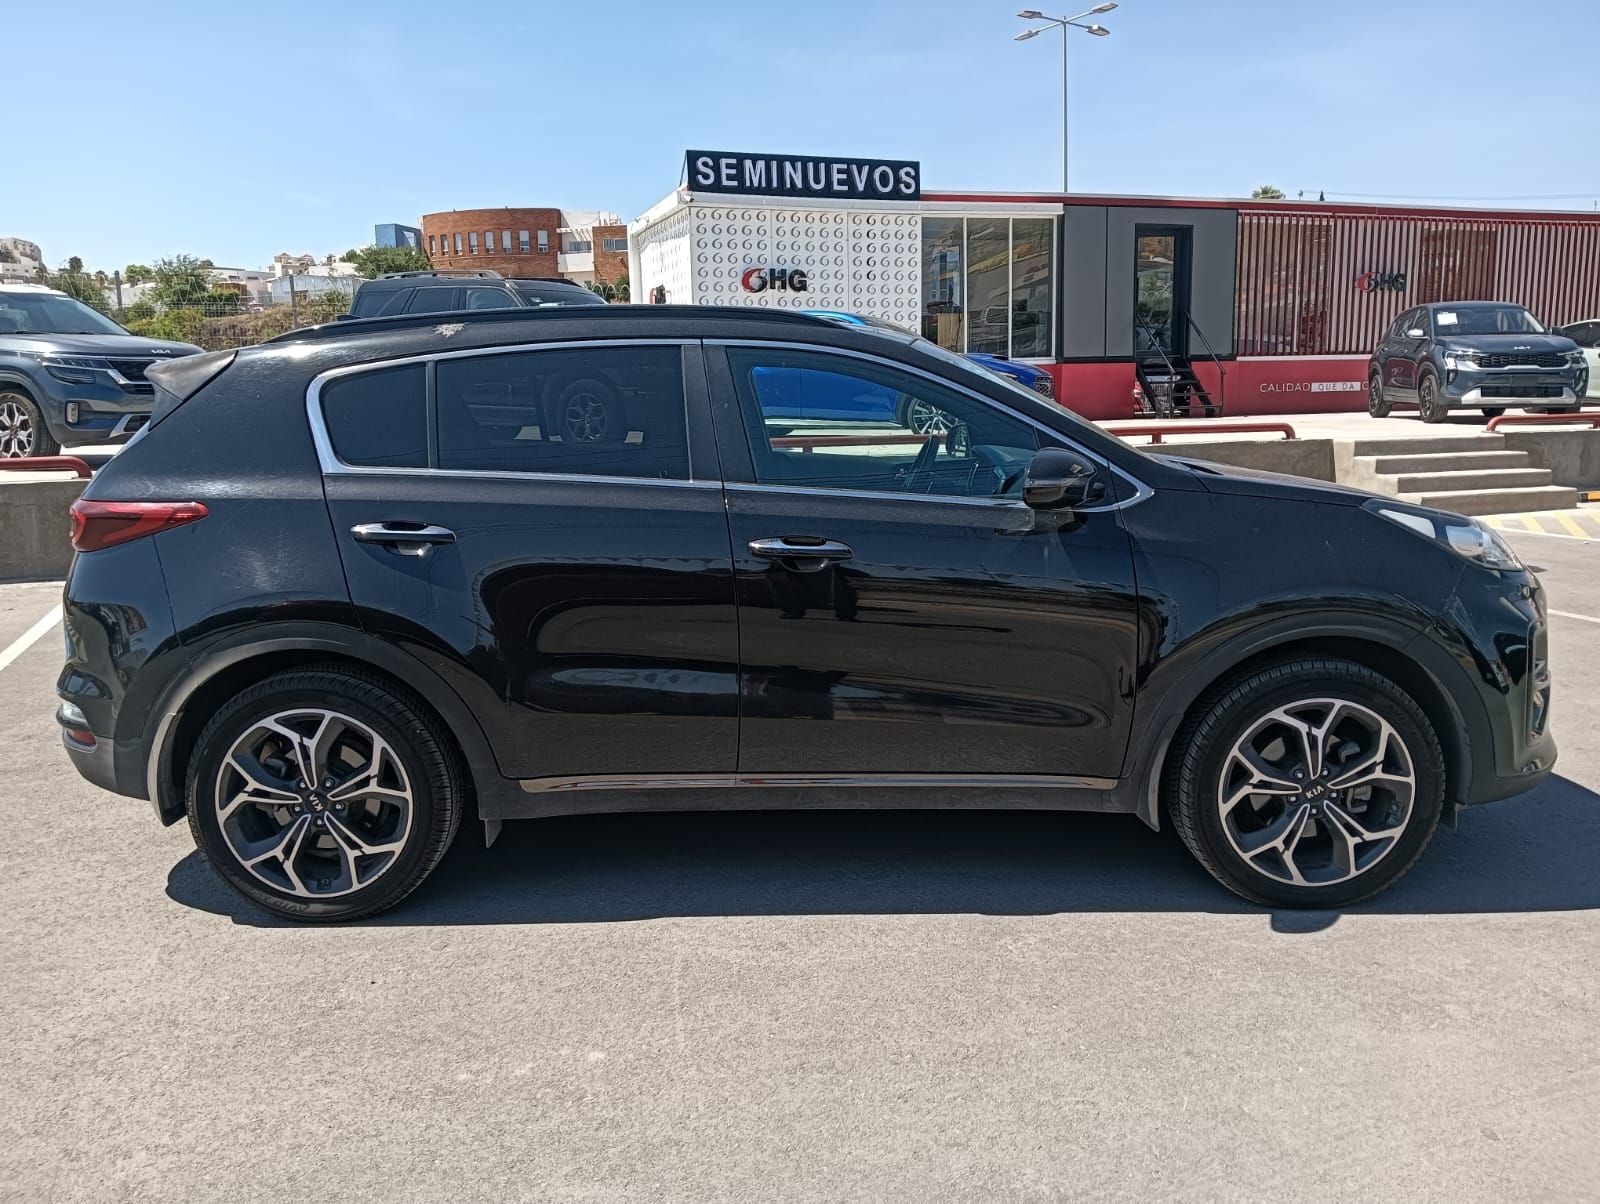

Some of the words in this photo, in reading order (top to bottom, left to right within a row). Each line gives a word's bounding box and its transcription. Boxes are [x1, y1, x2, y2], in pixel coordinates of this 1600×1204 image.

[695, 156, 917, 194] SEMINUEVOS
[1259, 383, 1311, 393] CALIDAD
[1317, 383, 1337, 391] QUE
[1342, 382, 1354, 391] DA
[1305, 785, 1325, 799] KIA
[308, 792, 324, 812] KIA
